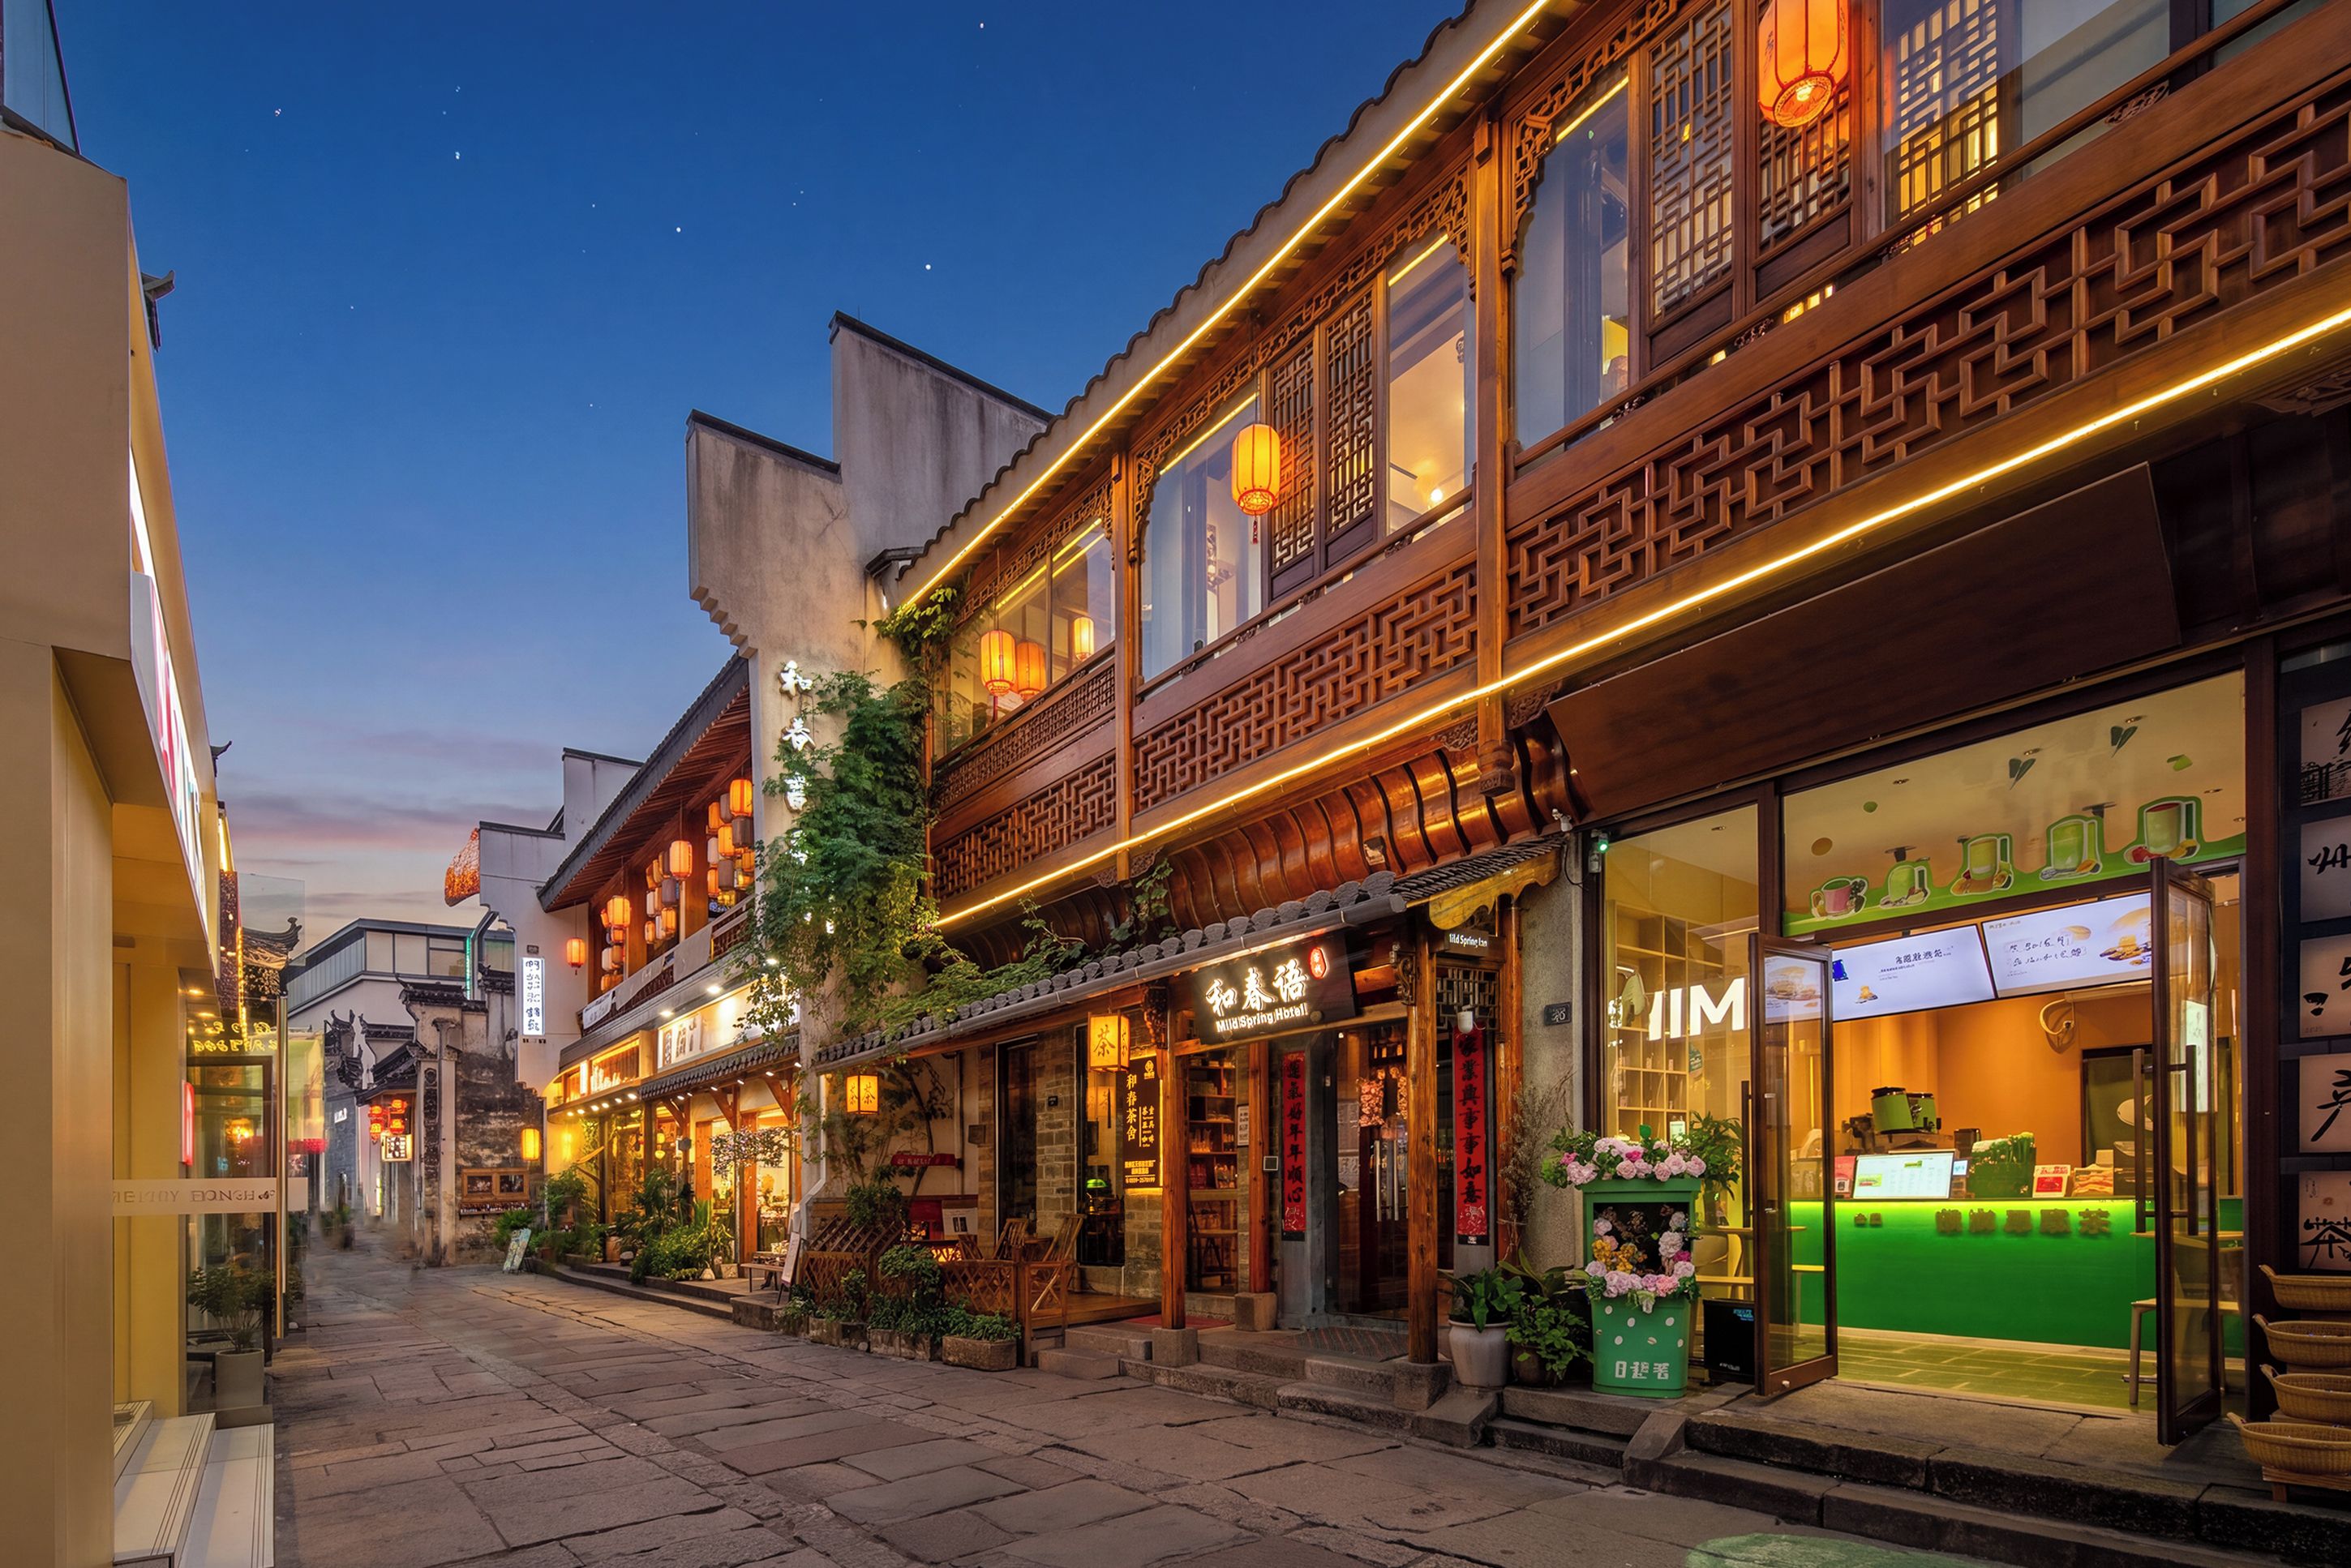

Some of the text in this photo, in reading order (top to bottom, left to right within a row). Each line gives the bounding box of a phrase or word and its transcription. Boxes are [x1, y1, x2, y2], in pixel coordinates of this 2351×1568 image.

[1460, 935, 1478, 948] Spring
[1205, 958, 1310, 1017] 和春语
[1216, 1018, 1239, 1032] Mild
[1239, 1013, 1275, 1028] Spring
[1093, 1024, 1116, 1057] 茶
[862, 1082, 876, 1105] 茶
[1126, 1073, 1137, 1142] 和春茶舍
